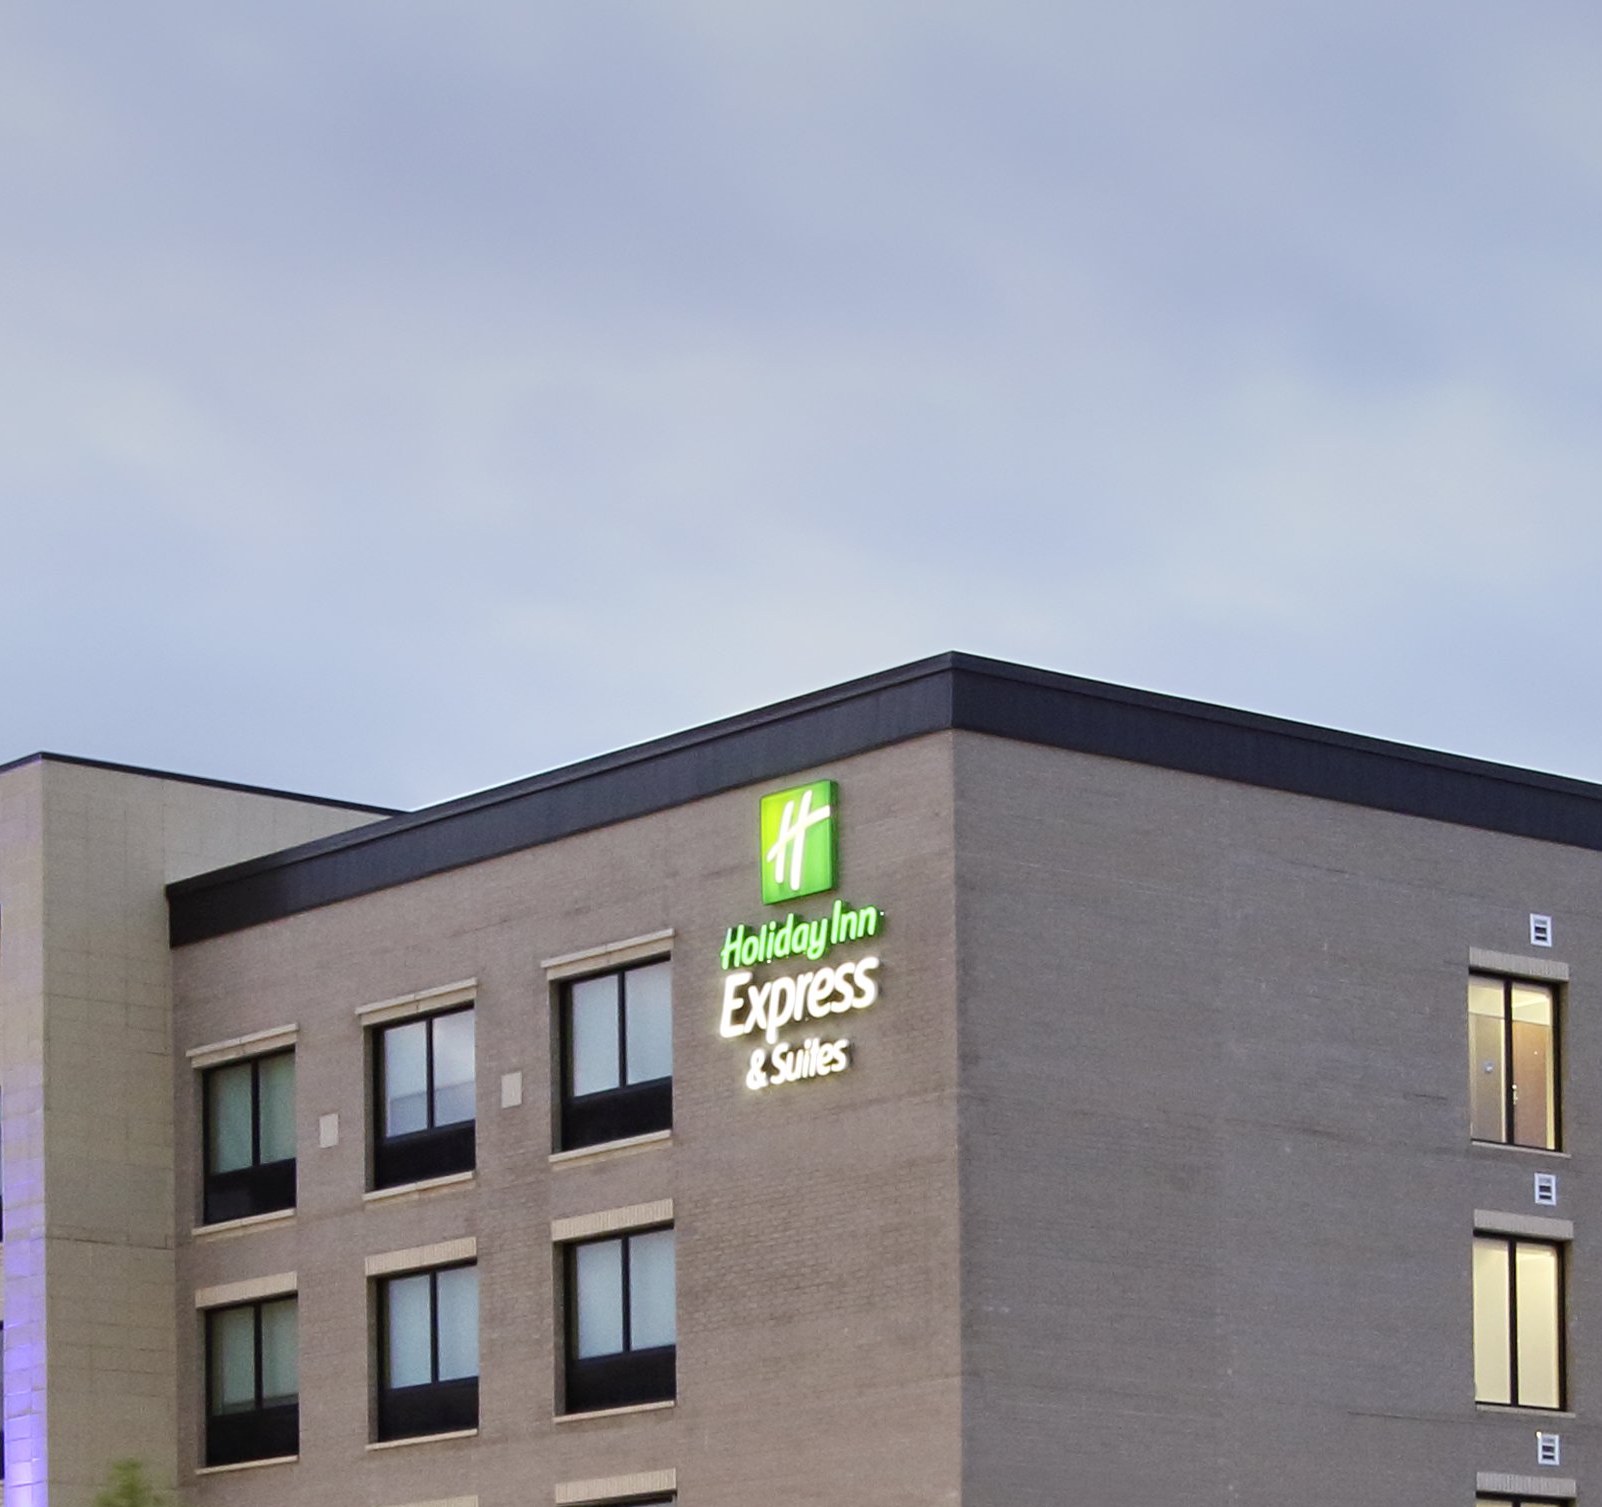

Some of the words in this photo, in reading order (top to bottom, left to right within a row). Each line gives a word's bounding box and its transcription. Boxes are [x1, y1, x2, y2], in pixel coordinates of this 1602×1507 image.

[720, 914, 829, 970] Holiday
[831, 900, 878, 944] Inn
[720, 957, 880, 1044] Express
[746, 1049, 769, 1090] &
[770, 1038, 849, 1085] Suites
